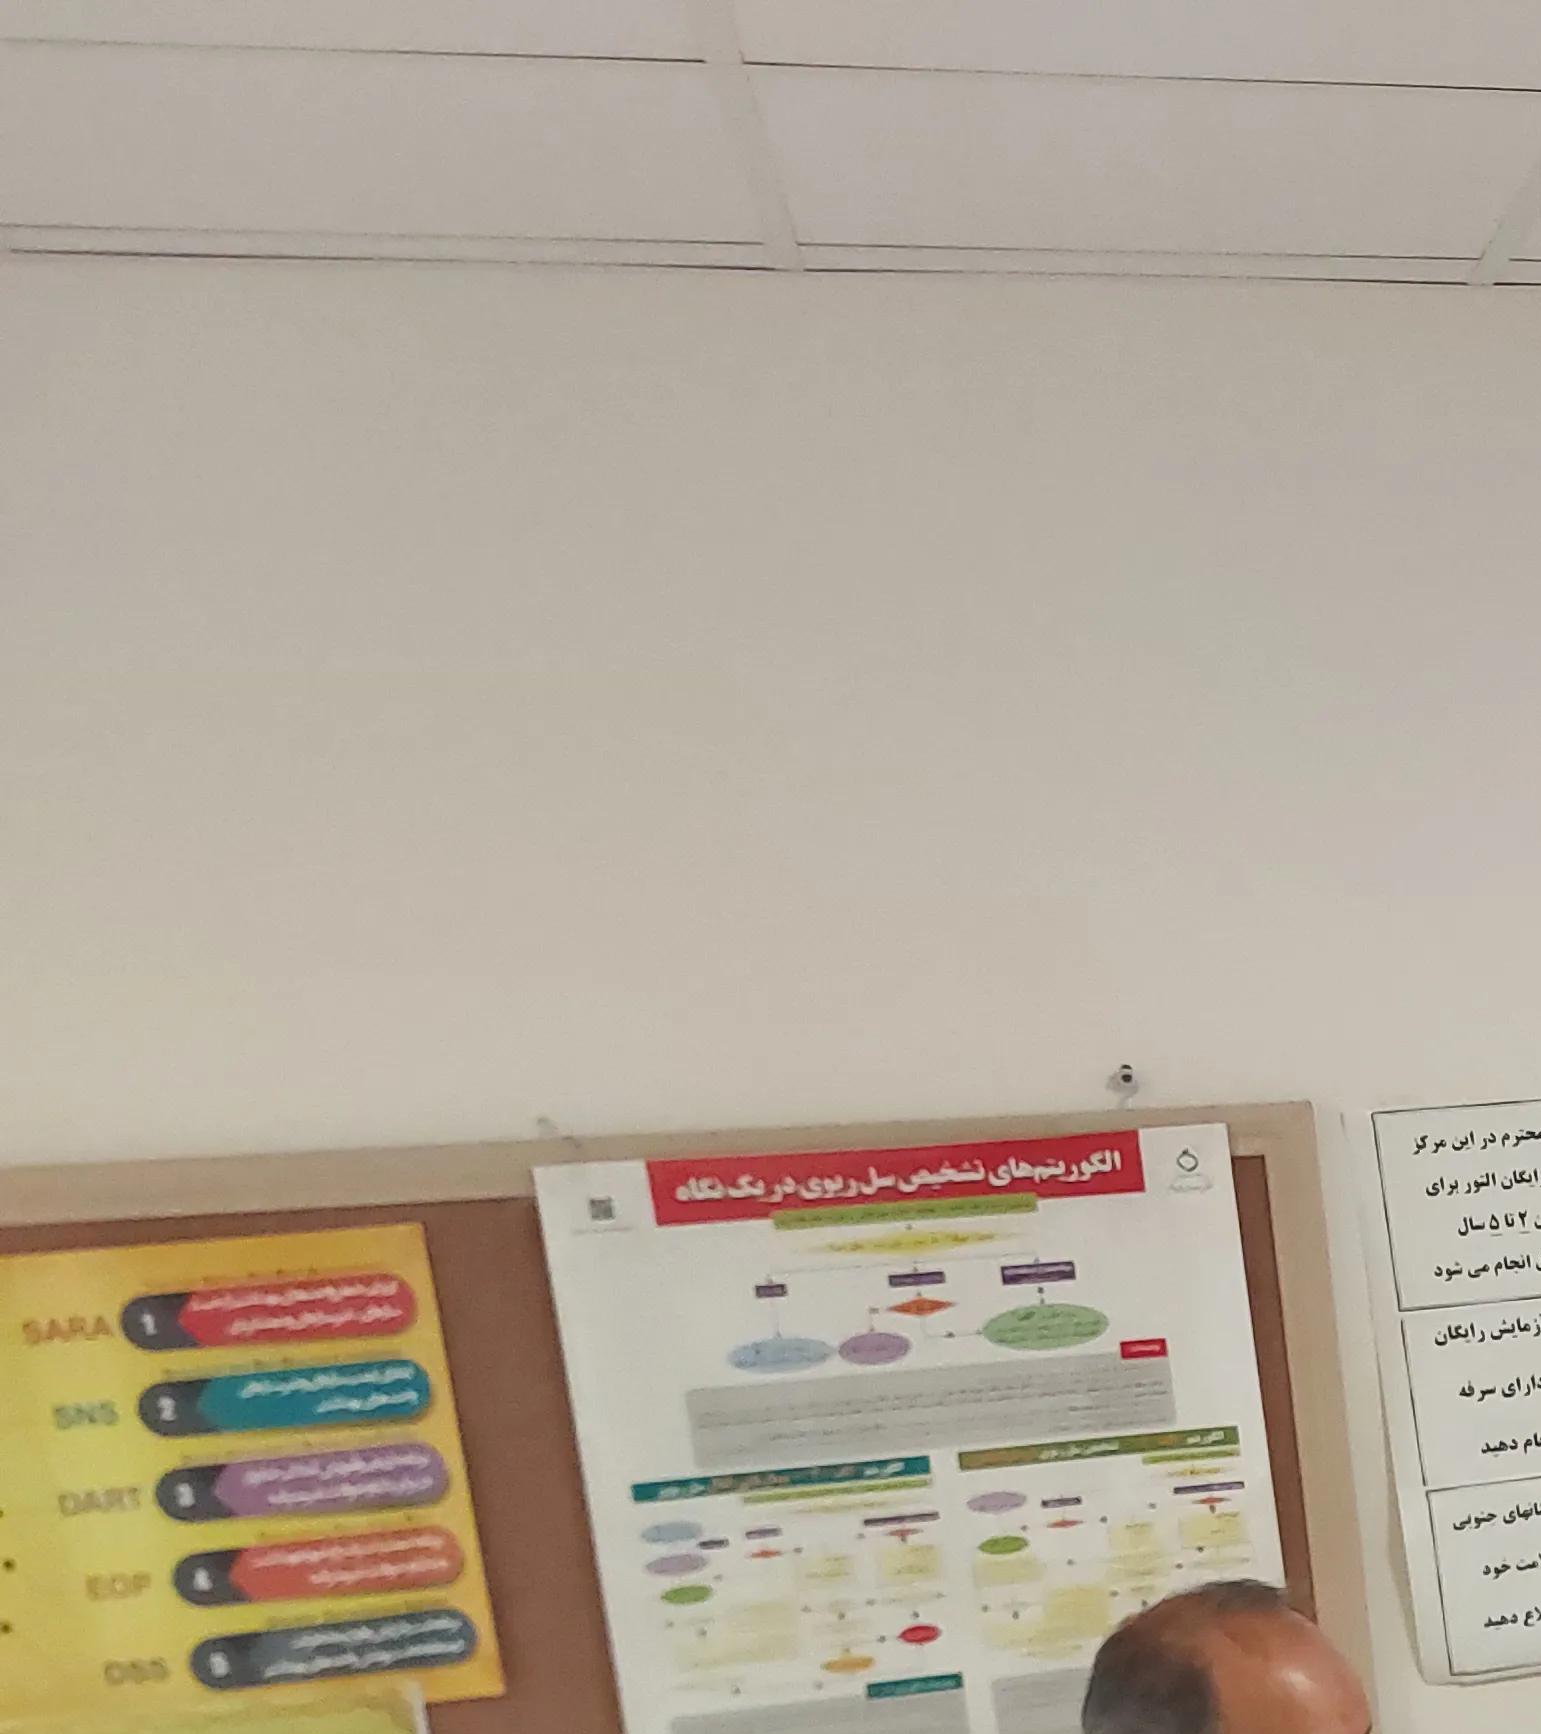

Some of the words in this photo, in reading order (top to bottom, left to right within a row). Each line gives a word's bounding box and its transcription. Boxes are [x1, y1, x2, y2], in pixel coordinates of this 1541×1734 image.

[1412, 1135, 1446, 1155] مرکز
[1452, 1131, 1474, 1150] این
[1480, 1132, 1496, 1149] در
[860, 1166, 896, 1195] سل
[898, 1159, 985, 1193] تشخیص
[1464, 1172, 1496, 1194] التور
[676, 1176, 725, 1201] نگاه
[727, 1175, 765, 1199] یک
[759, 1176, 796, 1203] در
[801, 1175, 859, 1199] ریوی
[1426, 1178, 1458, 1196] برای
[1458, 1217, 1485, 1236] سال
[1489, 1214, 1500, 1230] ۵
[1504, 1213, 1514, 1227] تا
[1518, 1210, 1528, 1228] ۲
[1434, 1262, 1463, 1281] شود
[1468, 1264, 1490, 1278] می
[1494, 1255, 1531, 1276] انجام
[21, 1315, 114, 1346] SARA
[141, 1314, 156, 1335] 1
[1434, 1323, 1485, 1345] رایگان
[1459, 1381, 1496, 1401] سرفه
[159, 1398, 178, 1422] 2
[1481, 1438, 1518, 1457] دهید
[1453, 1512, 1497, 1530] جنوبی
[1482, 1557, 1511, 1580] خود
[1484, 1613, 1518, 1630] دهید
